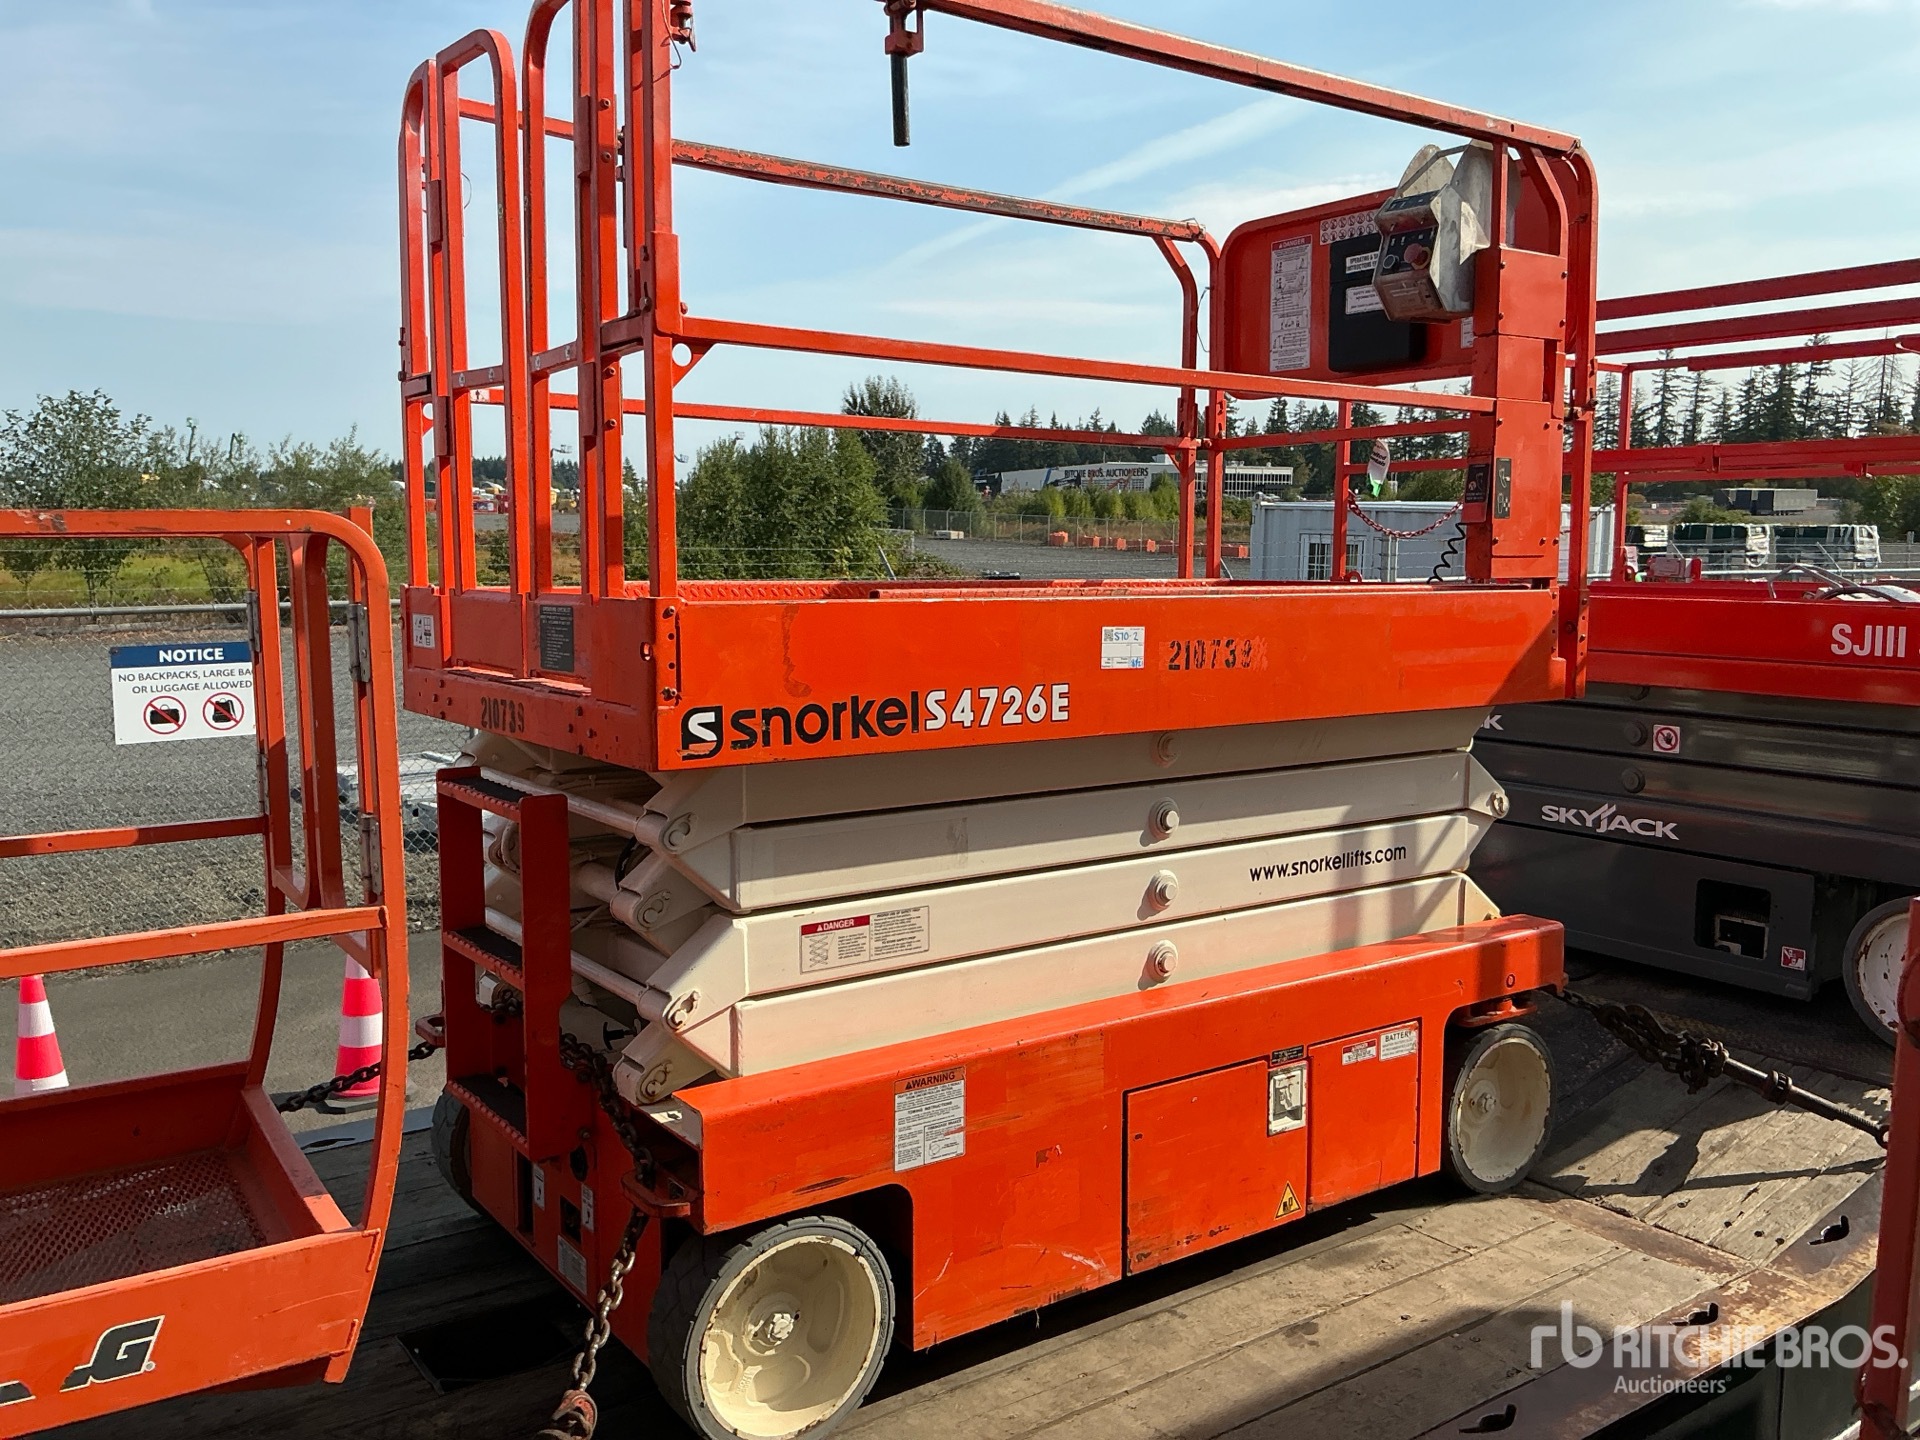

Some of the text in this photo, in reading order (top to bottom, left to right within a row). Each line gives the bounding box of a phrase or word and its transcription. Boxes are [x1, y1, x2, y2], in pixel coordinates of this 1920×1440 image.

[1282, 238, 1305, 248] DANGER
[1106, 467, 1149, 478] AUCTIONEERS
[1830, 623, 1907, 658] SJIII
[159, 648, 225, 663] NOTICE
[118, 667, 253, 683] NO BACKPACKS, LARGE BA
[132, 680, 253, 694] OR LUGGAGE ALLOWED
[480, 696, 525, 733] 210739
[730, 690, 919, 751] snorkel
[924, 683, 1071, 732] S4726E
[1541, 802, 1680, 841] SKYJACK
[1250, 846, 1407, 882] www.snorkellifts.com
[823, 918, 855, 931] DANGER
[911, 1071, 956, 1089] WARNING
